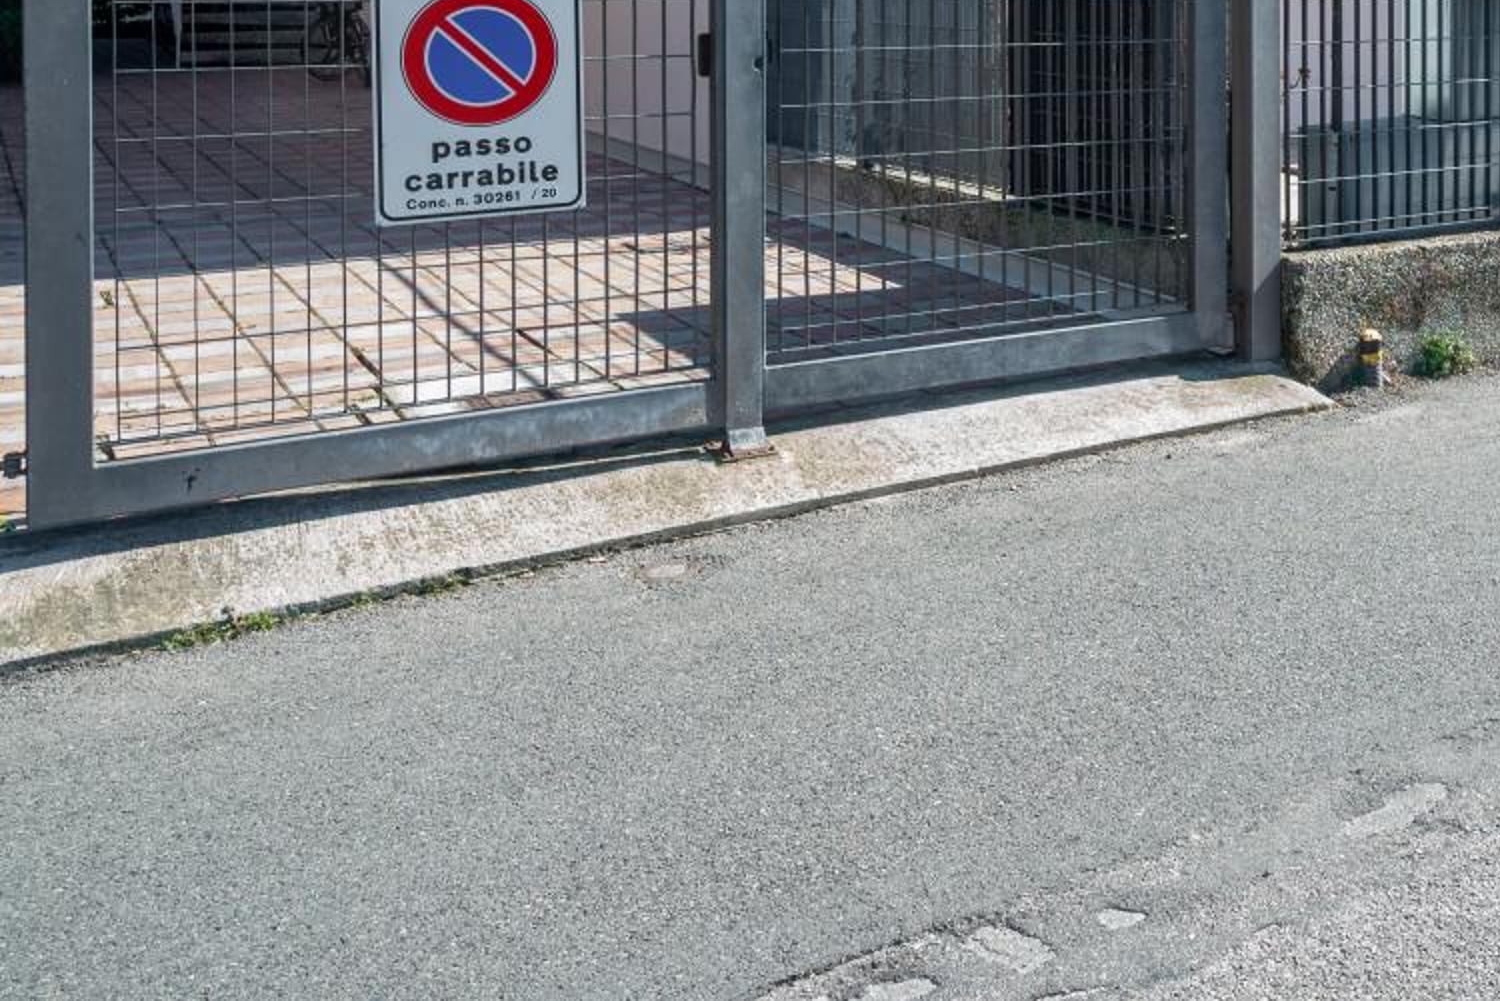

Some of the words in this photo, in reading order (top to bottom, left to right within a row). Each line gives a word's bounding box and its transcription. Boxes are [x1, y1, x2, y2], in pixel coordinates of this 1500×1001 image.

[431, 136, 532, 163] passo
[404, 161, 559, 192] carrabile
[406, 198, 450, 210] Conc.
[455, 197, 469, 207] n.
